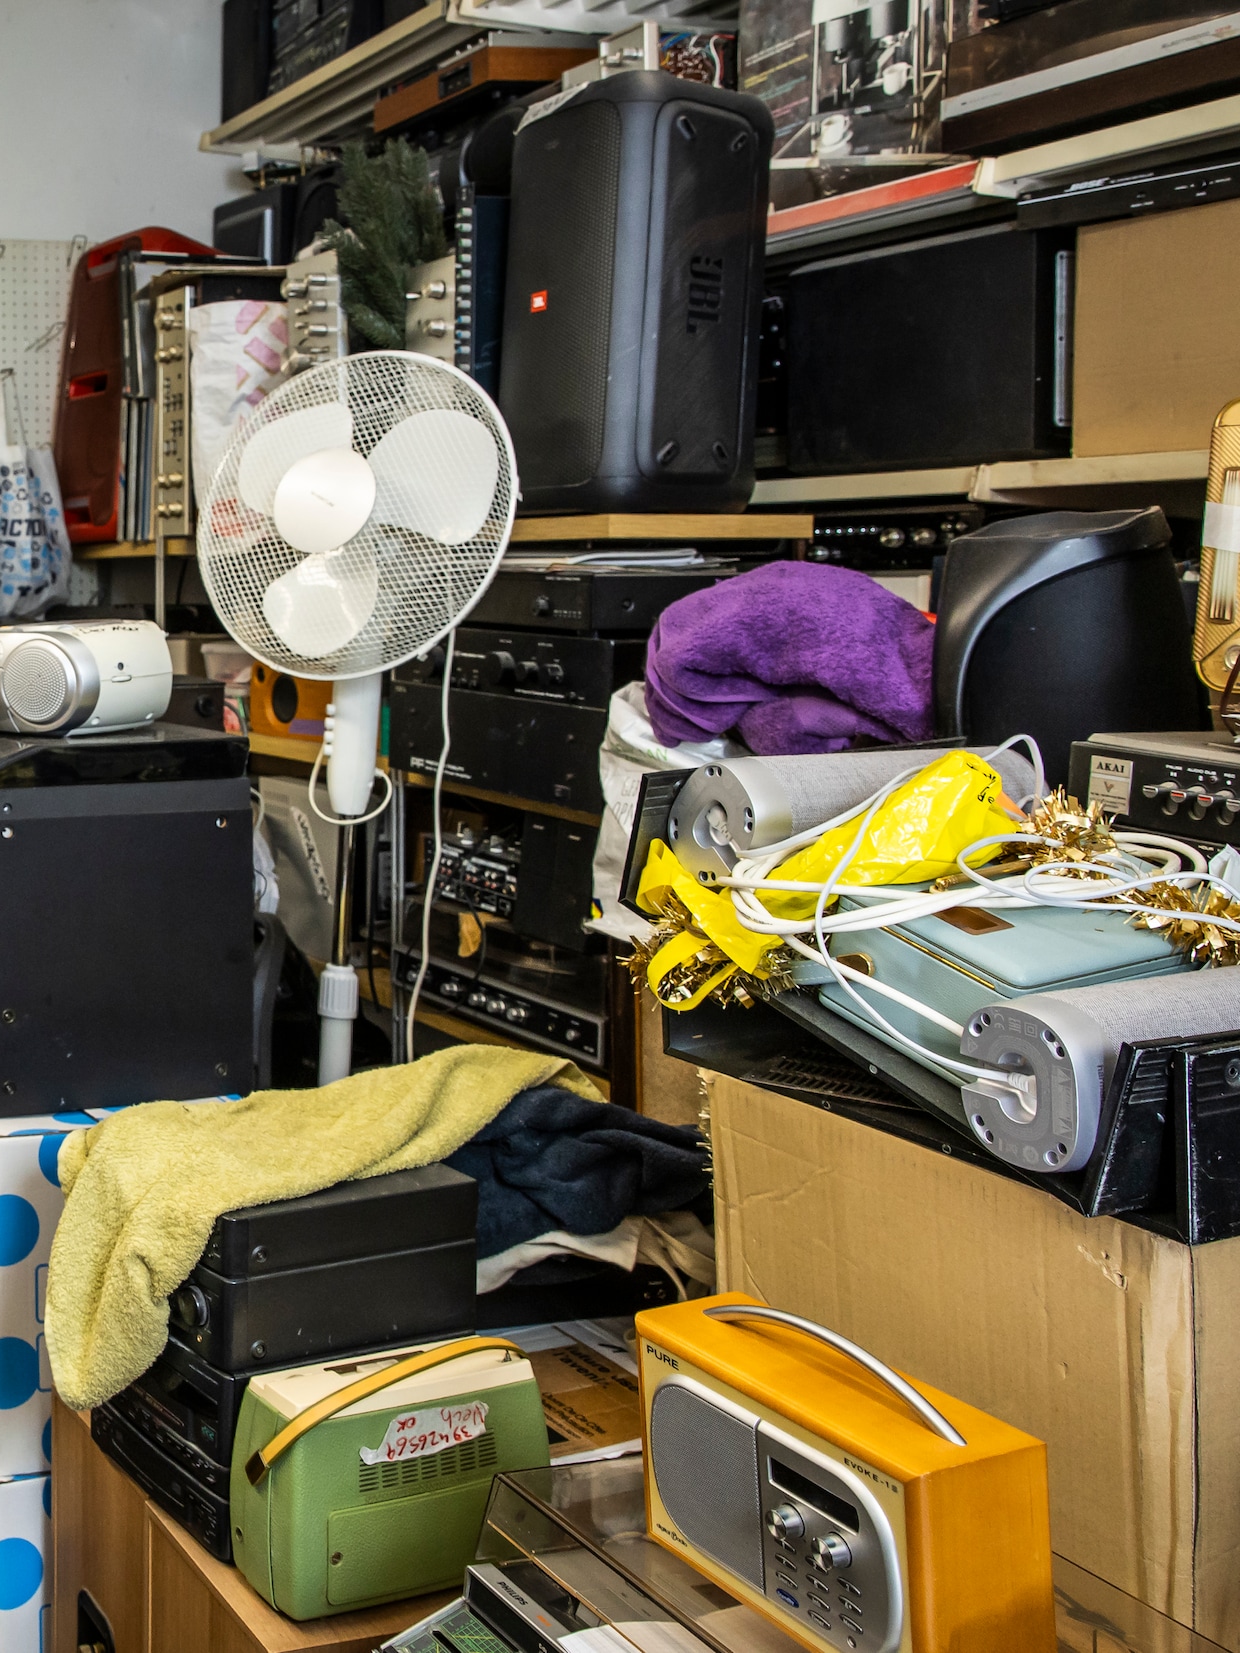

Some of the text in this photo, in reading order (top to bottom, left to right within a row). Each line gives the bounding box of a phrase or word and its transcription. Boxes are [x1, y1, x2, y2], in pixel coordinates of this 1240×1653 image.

[1096, 761, 1125, 774] AKAI
[646, 1344, 680, 1371] PURE
[497, 1581, 529, 1606] PHILIPS
